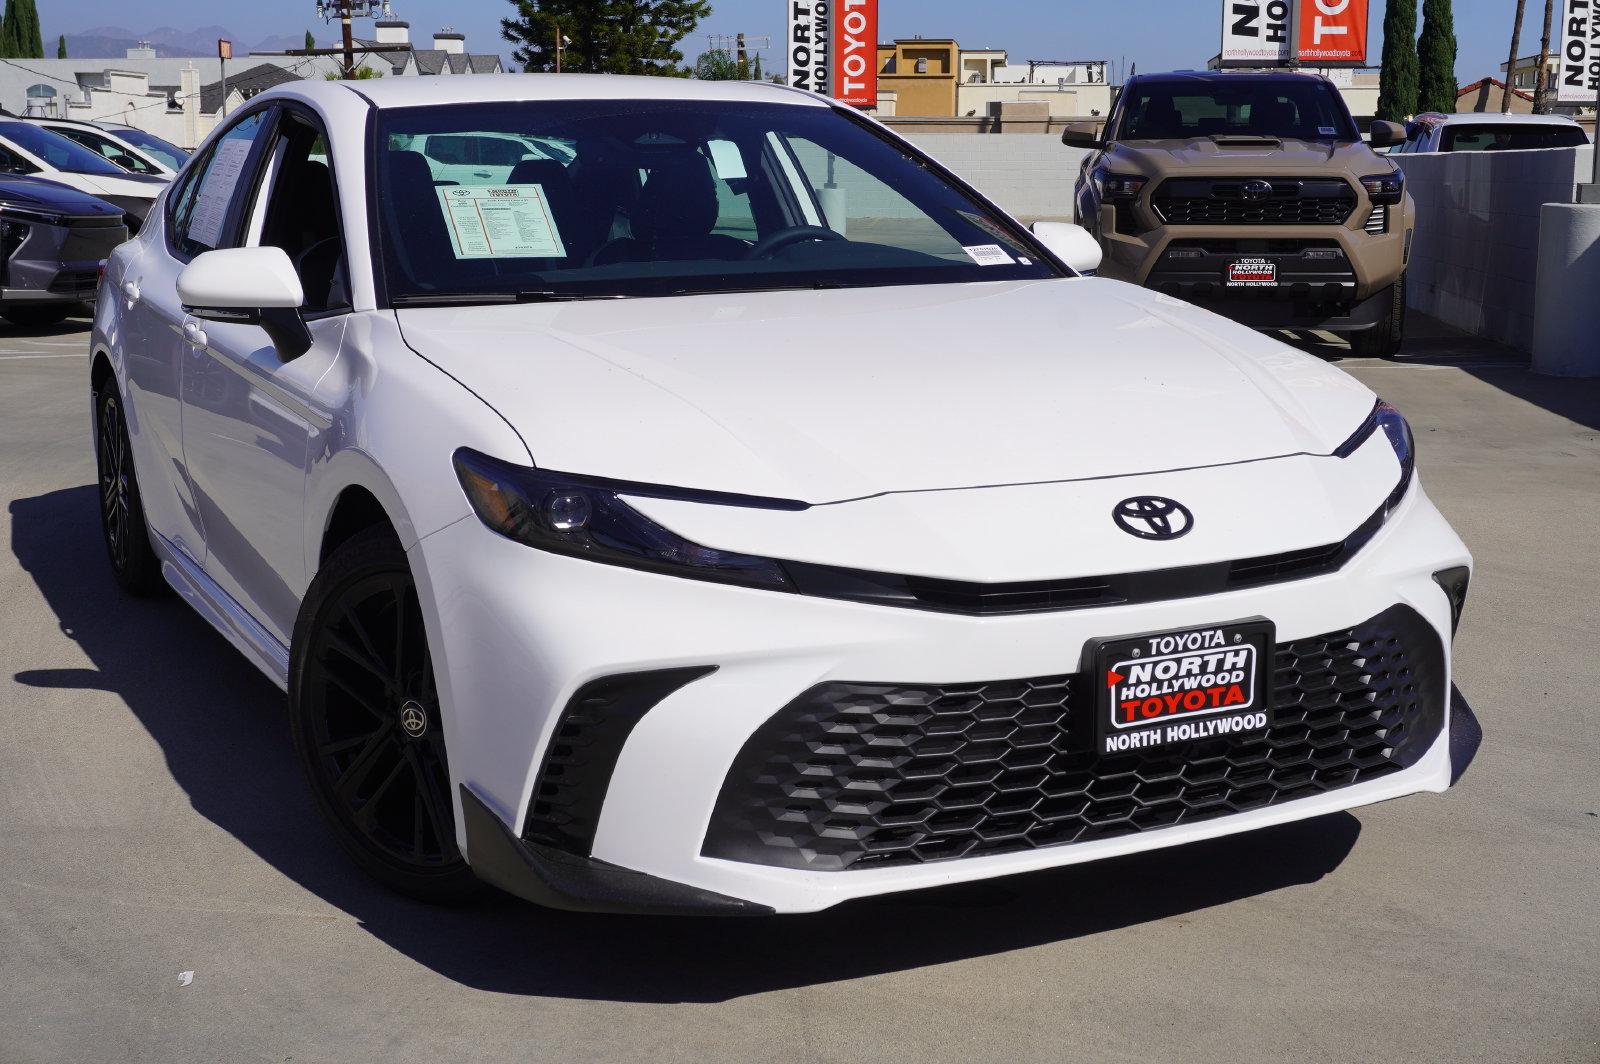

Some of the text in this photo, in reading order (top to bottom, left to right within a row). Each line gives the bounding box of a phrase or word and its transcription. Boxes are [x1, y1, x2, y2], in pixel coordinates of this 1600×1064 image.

[814, 0, 828, 94] HOLLYWO
[1149, 630, 1226, 655] TOYOTA
[1120, 670, 1245, 700] HOLLYWOOD
[1128, 650, 1248, 684] NORTH
[1120, 684, 1246, 722] TOYOTA
[1106, 713, 1267, 752] NORTH HOLLYWOOD
